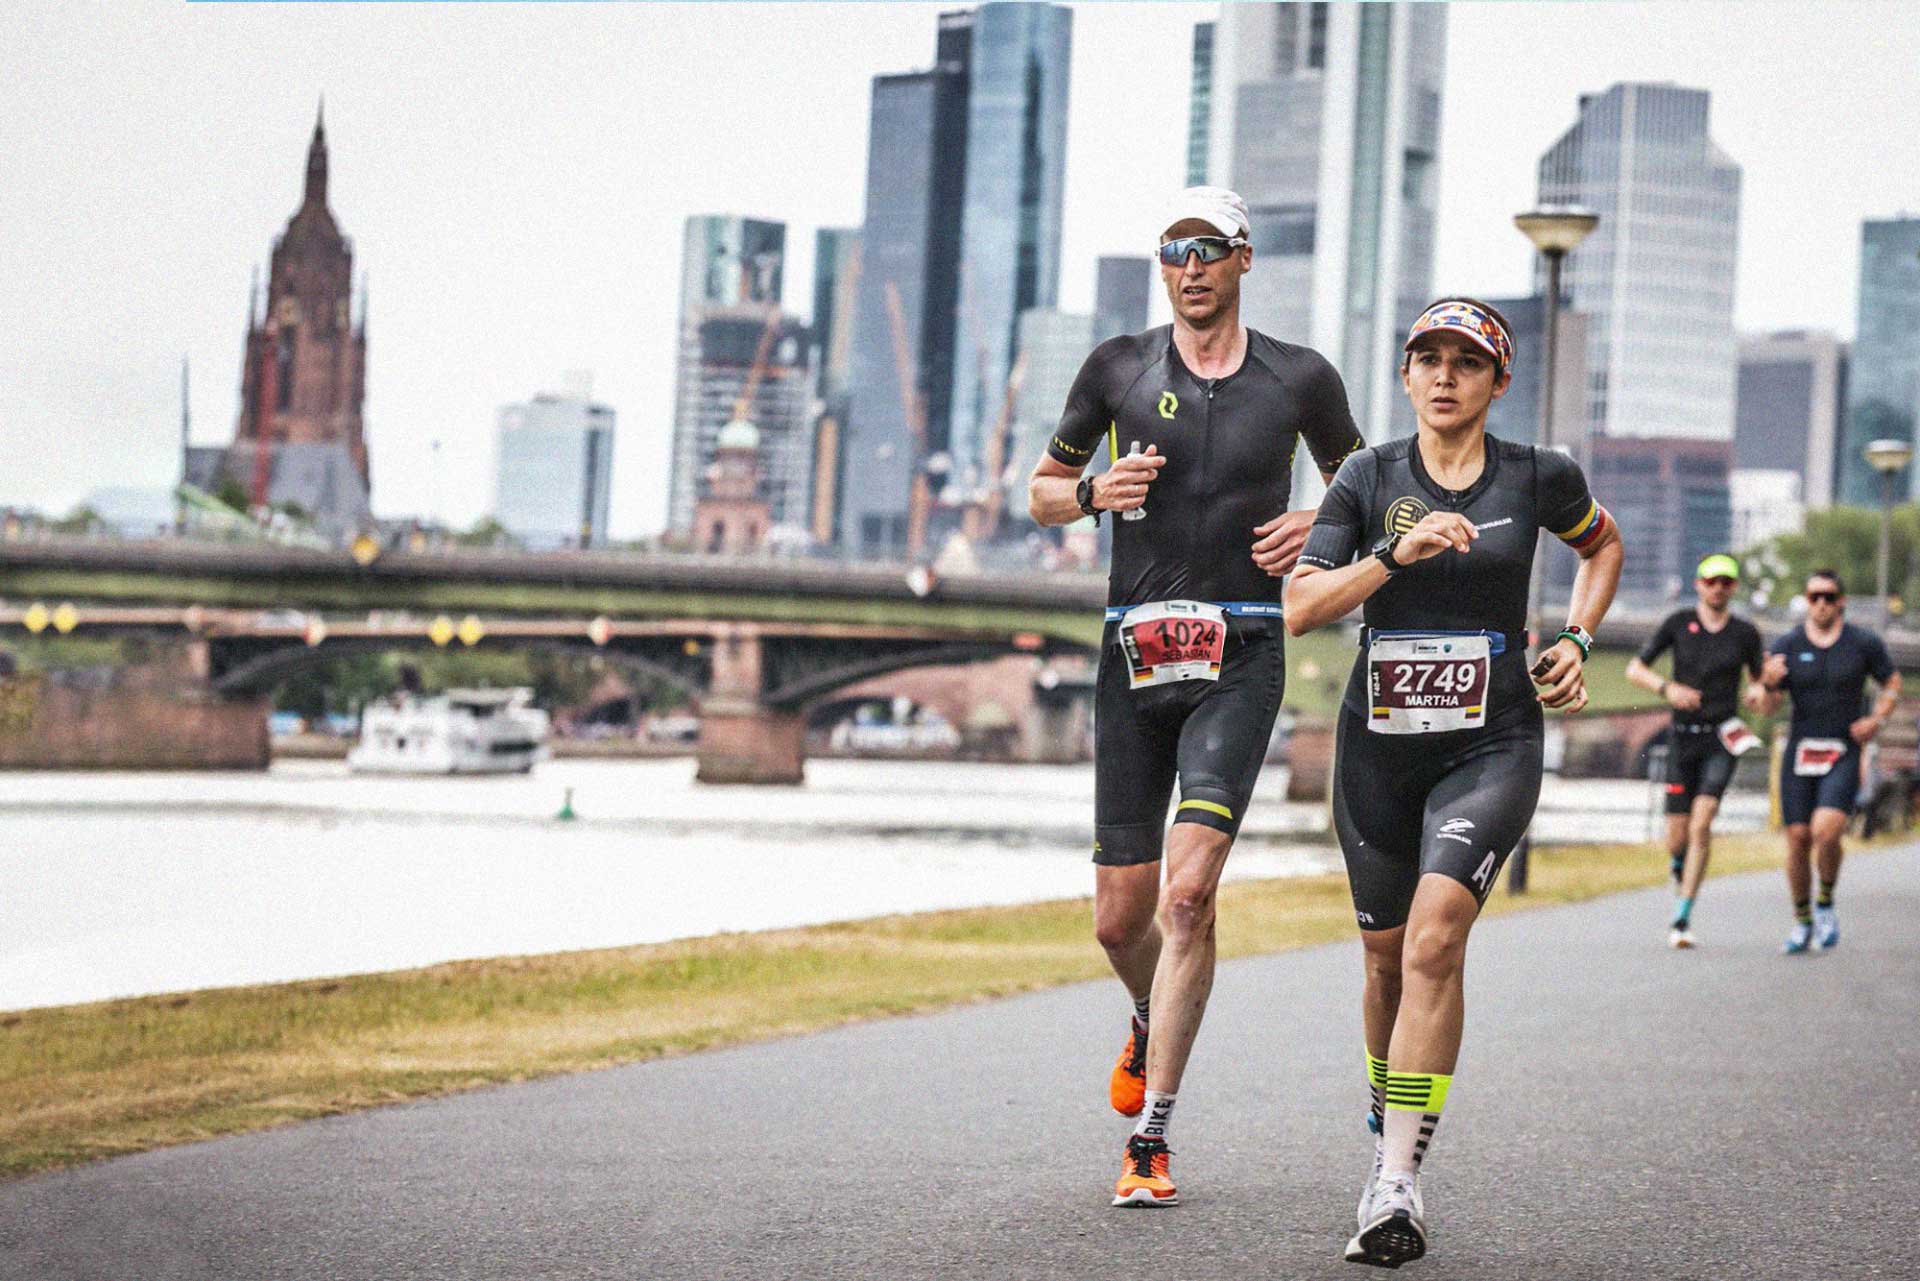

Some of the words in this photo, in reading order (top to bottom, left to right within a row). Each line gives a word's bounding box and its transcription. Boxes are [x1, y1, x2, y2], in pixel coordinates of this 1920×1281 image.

[1154, 621, 1217, 648] 1024
[1393, 663, 1476, 693] 2749
[1404, 695, 1459, 706] MARTHA
[1143, 1101, 1171, 1135] BIKE
